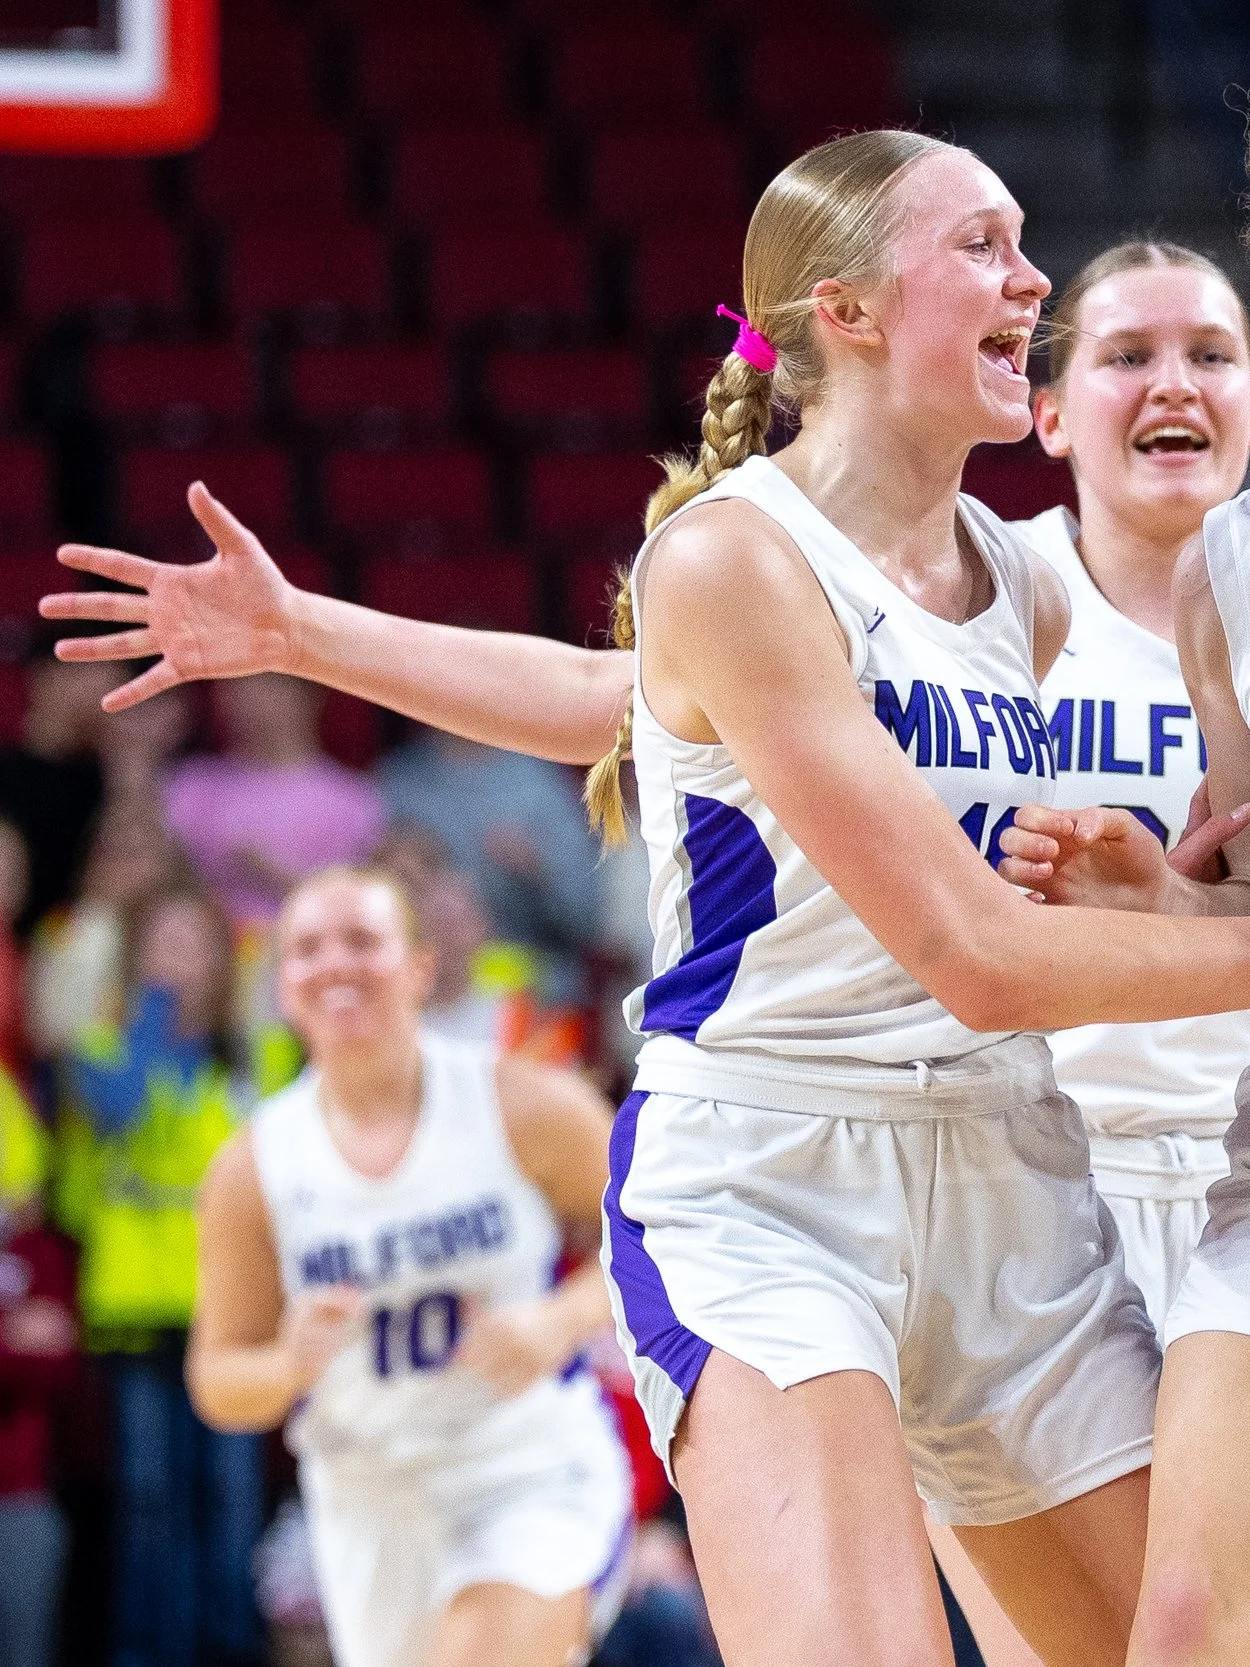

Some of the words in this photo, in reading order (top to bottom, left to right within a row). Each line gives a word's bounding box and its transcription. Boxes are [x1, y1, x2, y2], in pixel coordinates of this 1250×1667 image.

[874, 679, 1057, 780] MILFOR
[1049, 698, 1208, 776] MILF
[299, 1195, 513, 1287] MILFORD
[369, 1291, 462, 1378] 10
